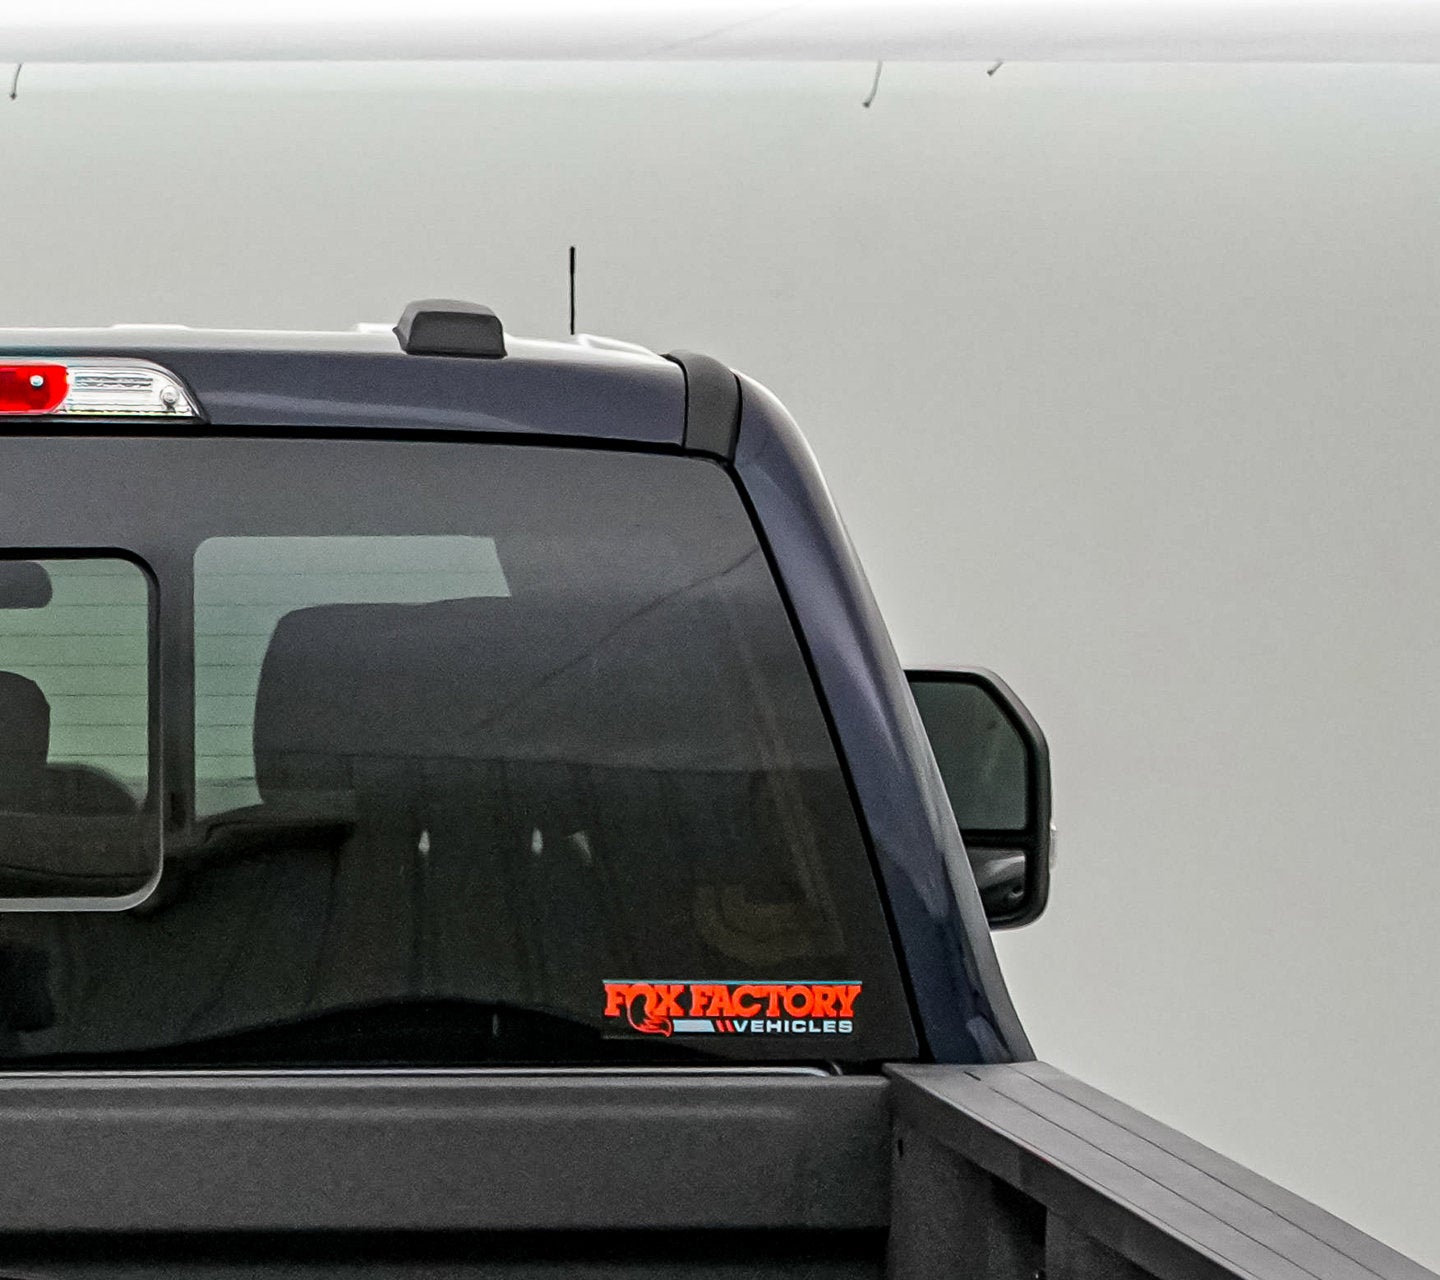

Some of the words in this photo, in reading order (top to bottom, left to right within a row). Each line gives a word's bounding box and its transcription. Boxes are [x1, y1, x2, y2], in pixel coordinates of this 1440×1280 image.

[604, 983, 684, 1037] FOX
[689, 984, 862, 1018] FACTORY
[734, 1020, 854, 1034] VEHICLES
